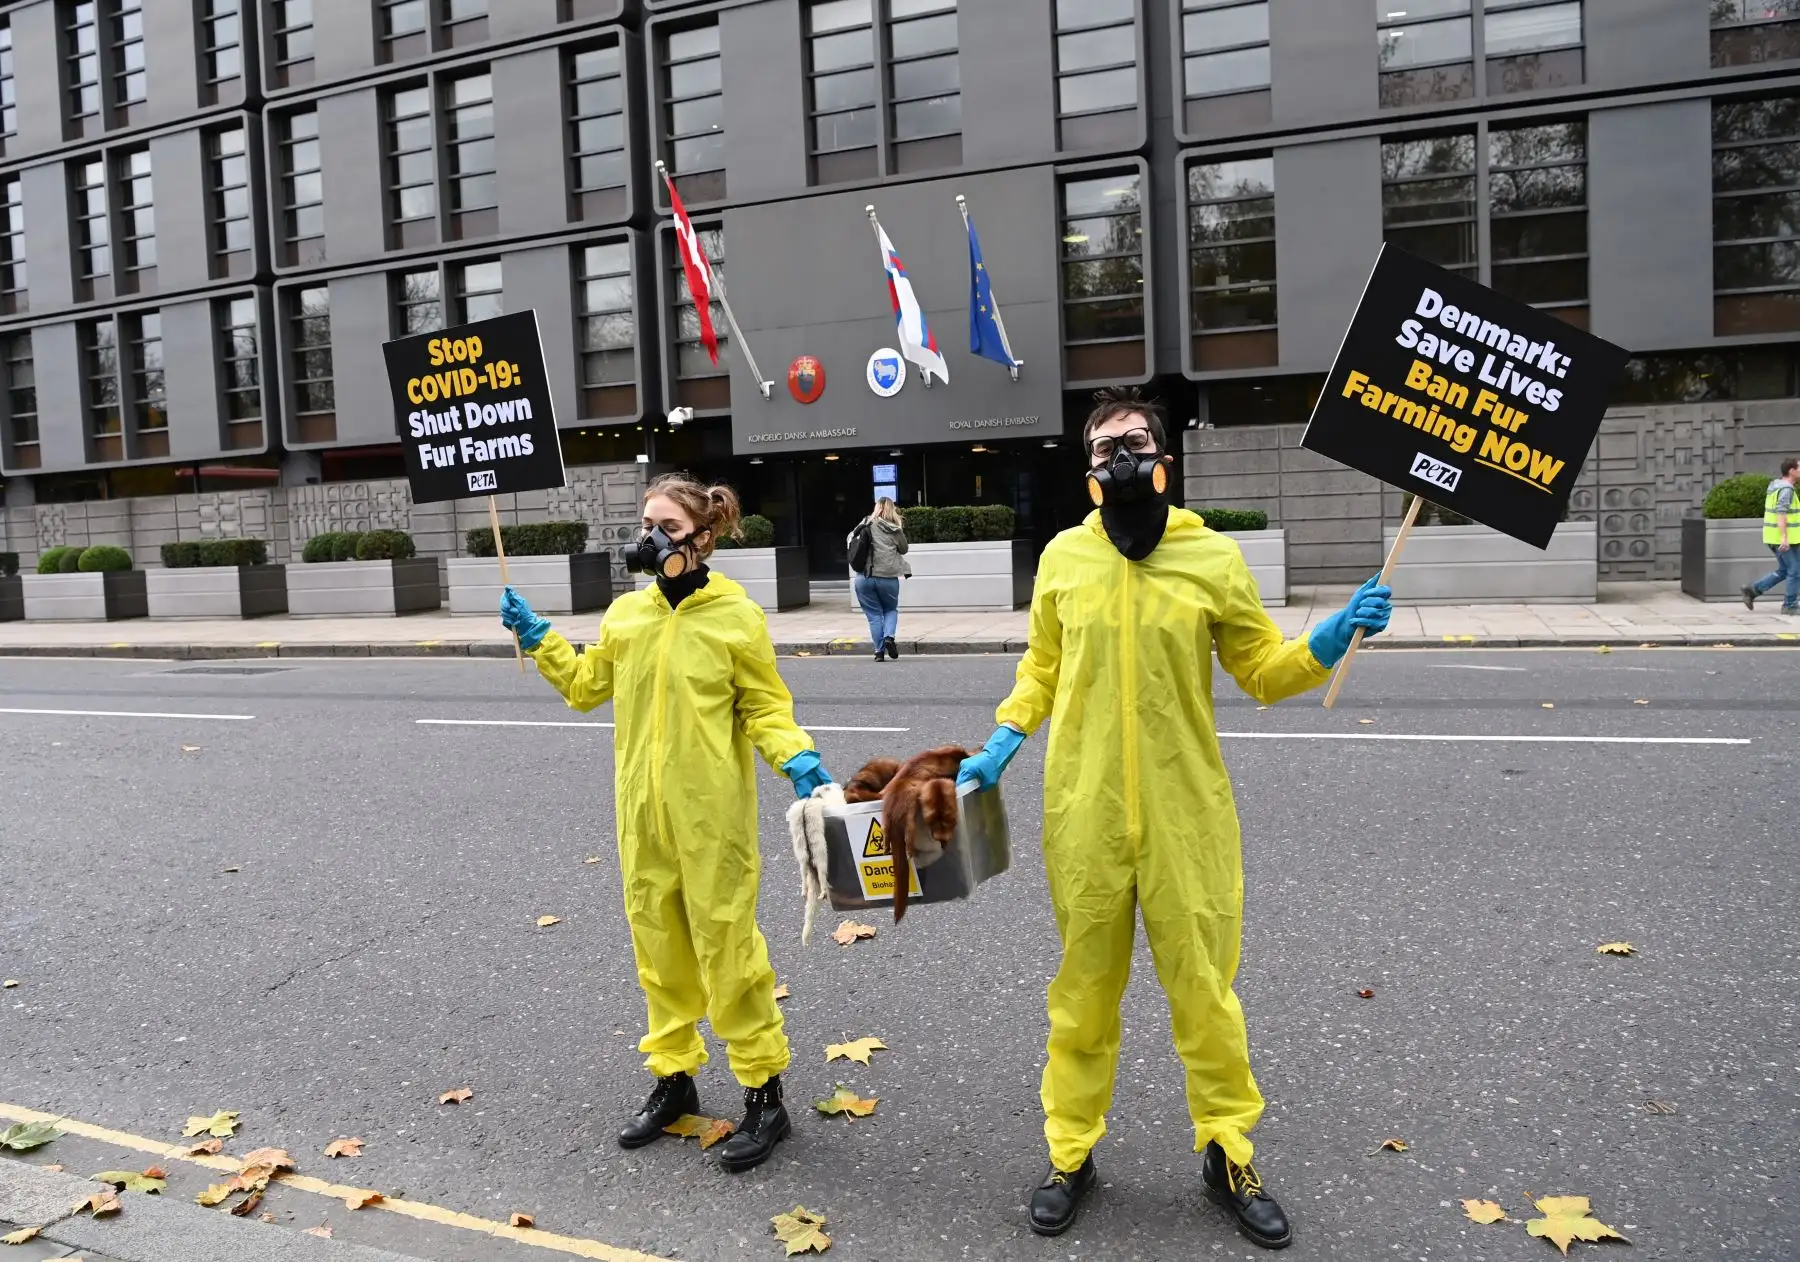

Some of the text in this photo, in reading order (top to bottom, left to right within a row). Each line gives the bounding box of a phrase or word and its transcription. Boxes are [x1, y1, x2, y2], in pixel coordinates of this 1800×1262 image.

[428, 335, 483, 366] Stop
[1414, 287, 1572, 379] Denmark:
[407, 360, 522, 404] COVID-19:
[1395, 319, 1564, 412] Save Lives
[1404, 359, 1529, 433] Ban Fur
[408, 397, 533, 437] Shut Down
[784, 431, 808, 441] DANSK
[810, 427, 857, 439] AMBASSADE
[949, 416, 1039, 430] ROYAL DANISH EMBASSY
[1341, 369, 1566, 486] Farming NOW
[418, 433, 534, 470] Fur Farms
[864, 865, 896, 877] Dang
